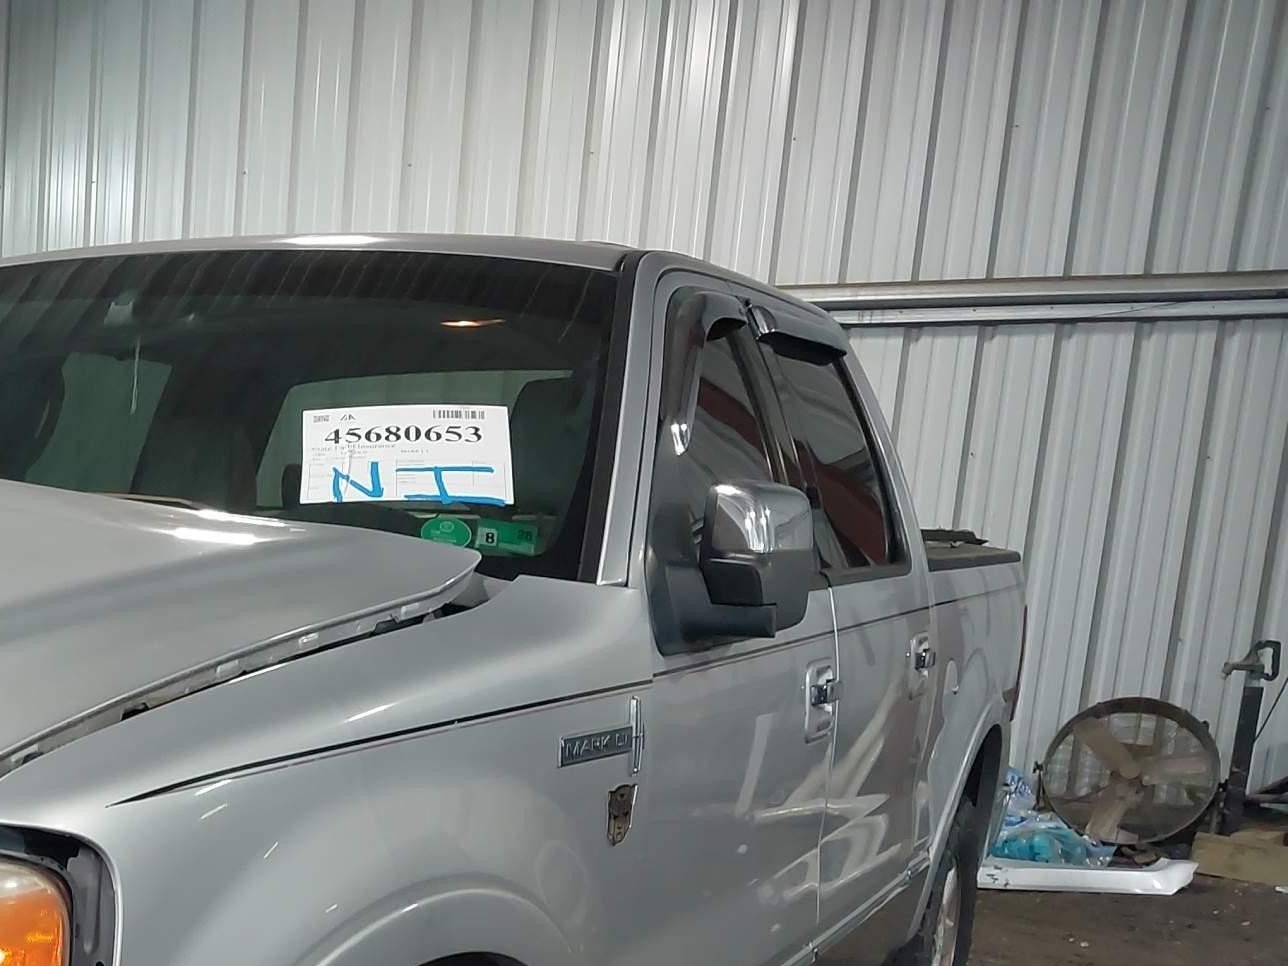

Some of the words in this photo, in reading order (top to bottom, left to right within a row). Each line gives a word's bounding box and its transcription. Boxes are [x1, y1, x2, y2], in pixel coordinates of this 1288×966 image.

[324, 425, 482, 444] 45680653
[485, 532, 494, 544] 8
[566, 734, 611, 757] MARK
